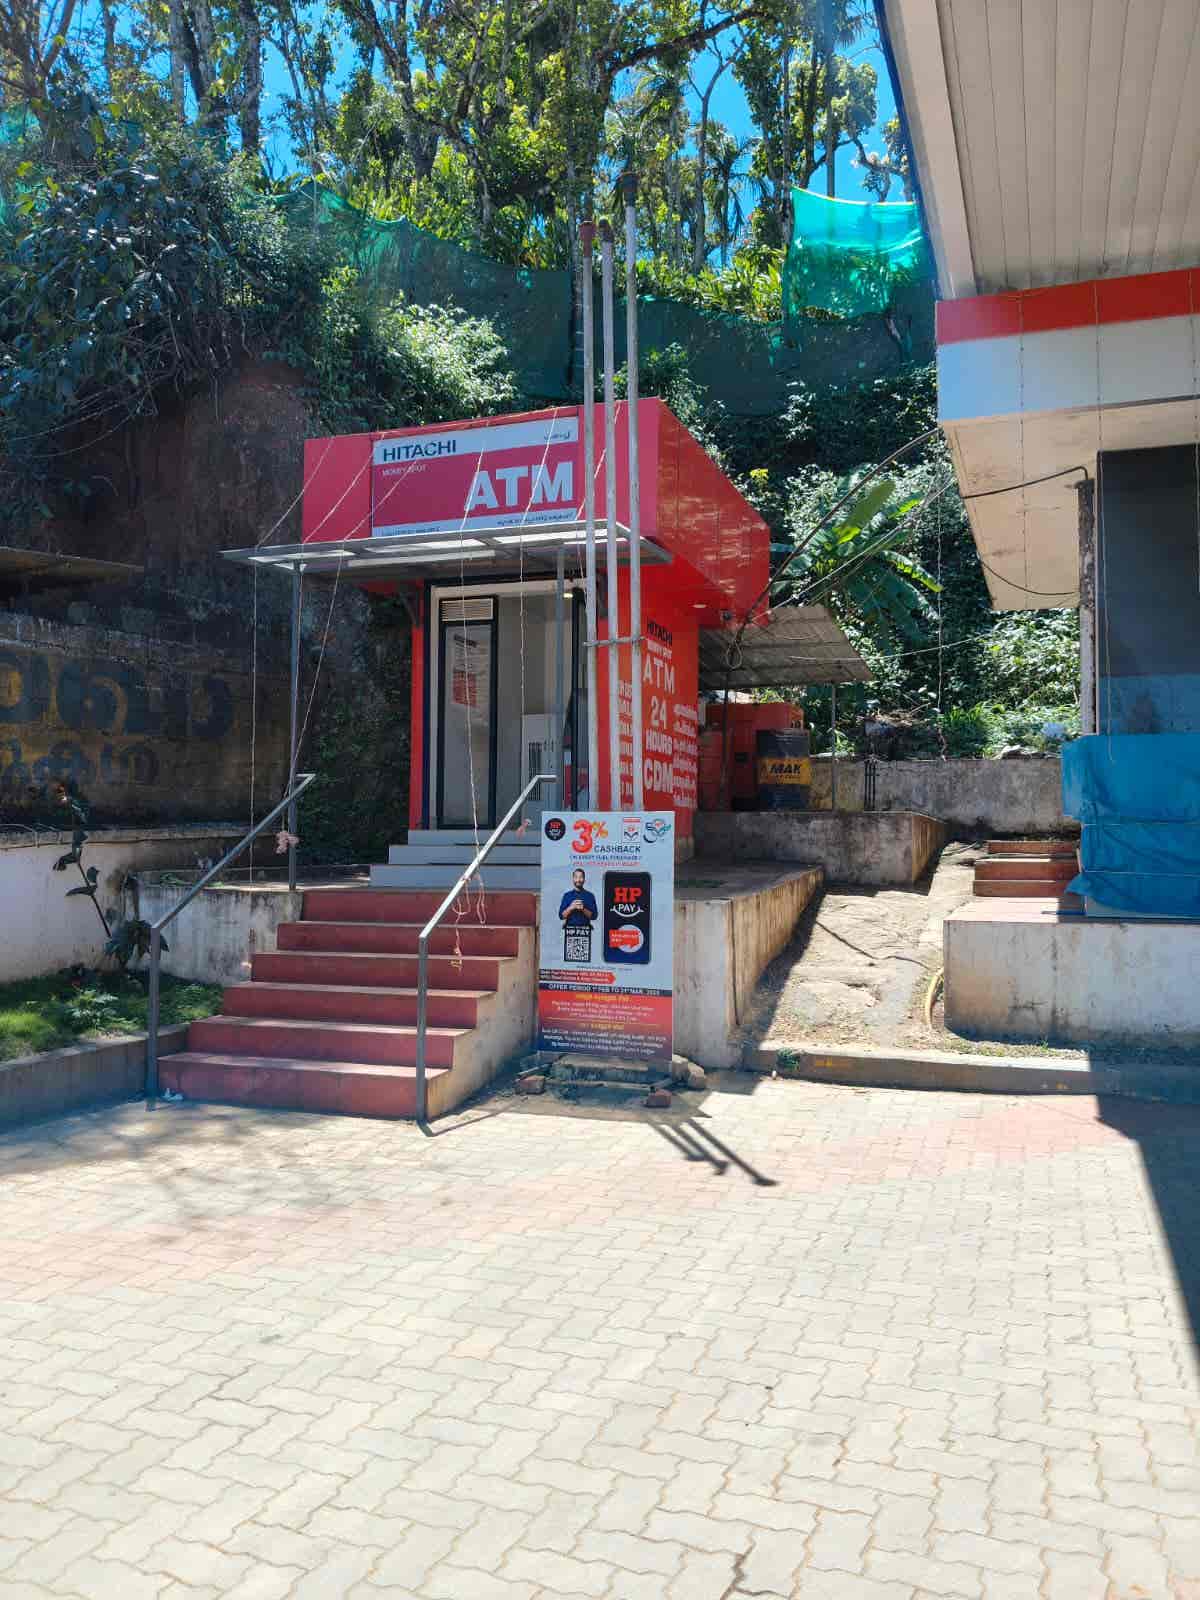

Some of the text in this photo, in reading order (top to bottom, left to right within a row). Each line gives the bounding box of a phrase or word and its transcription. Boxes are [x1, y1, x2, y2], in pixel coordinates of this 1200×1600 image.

[383, 439, 456, 462] HITACHI
[463, 461, 574, 512] ATM
[647, 620, 672, 646] HITACHI
[643, 655, 675, 694] ATM
[651, 696, 667, 729] 24
[646, 730, 672, 755] HOURS
[643, 758, 673, 793] CDM
[770, 764, 802, 774] MAK
[572, 819, 608, 853] 3%
[594, 845, 641, 853] CASHBACK
[614, 886, 642, 903] HP
[618, 904, 636, 913] PAY
